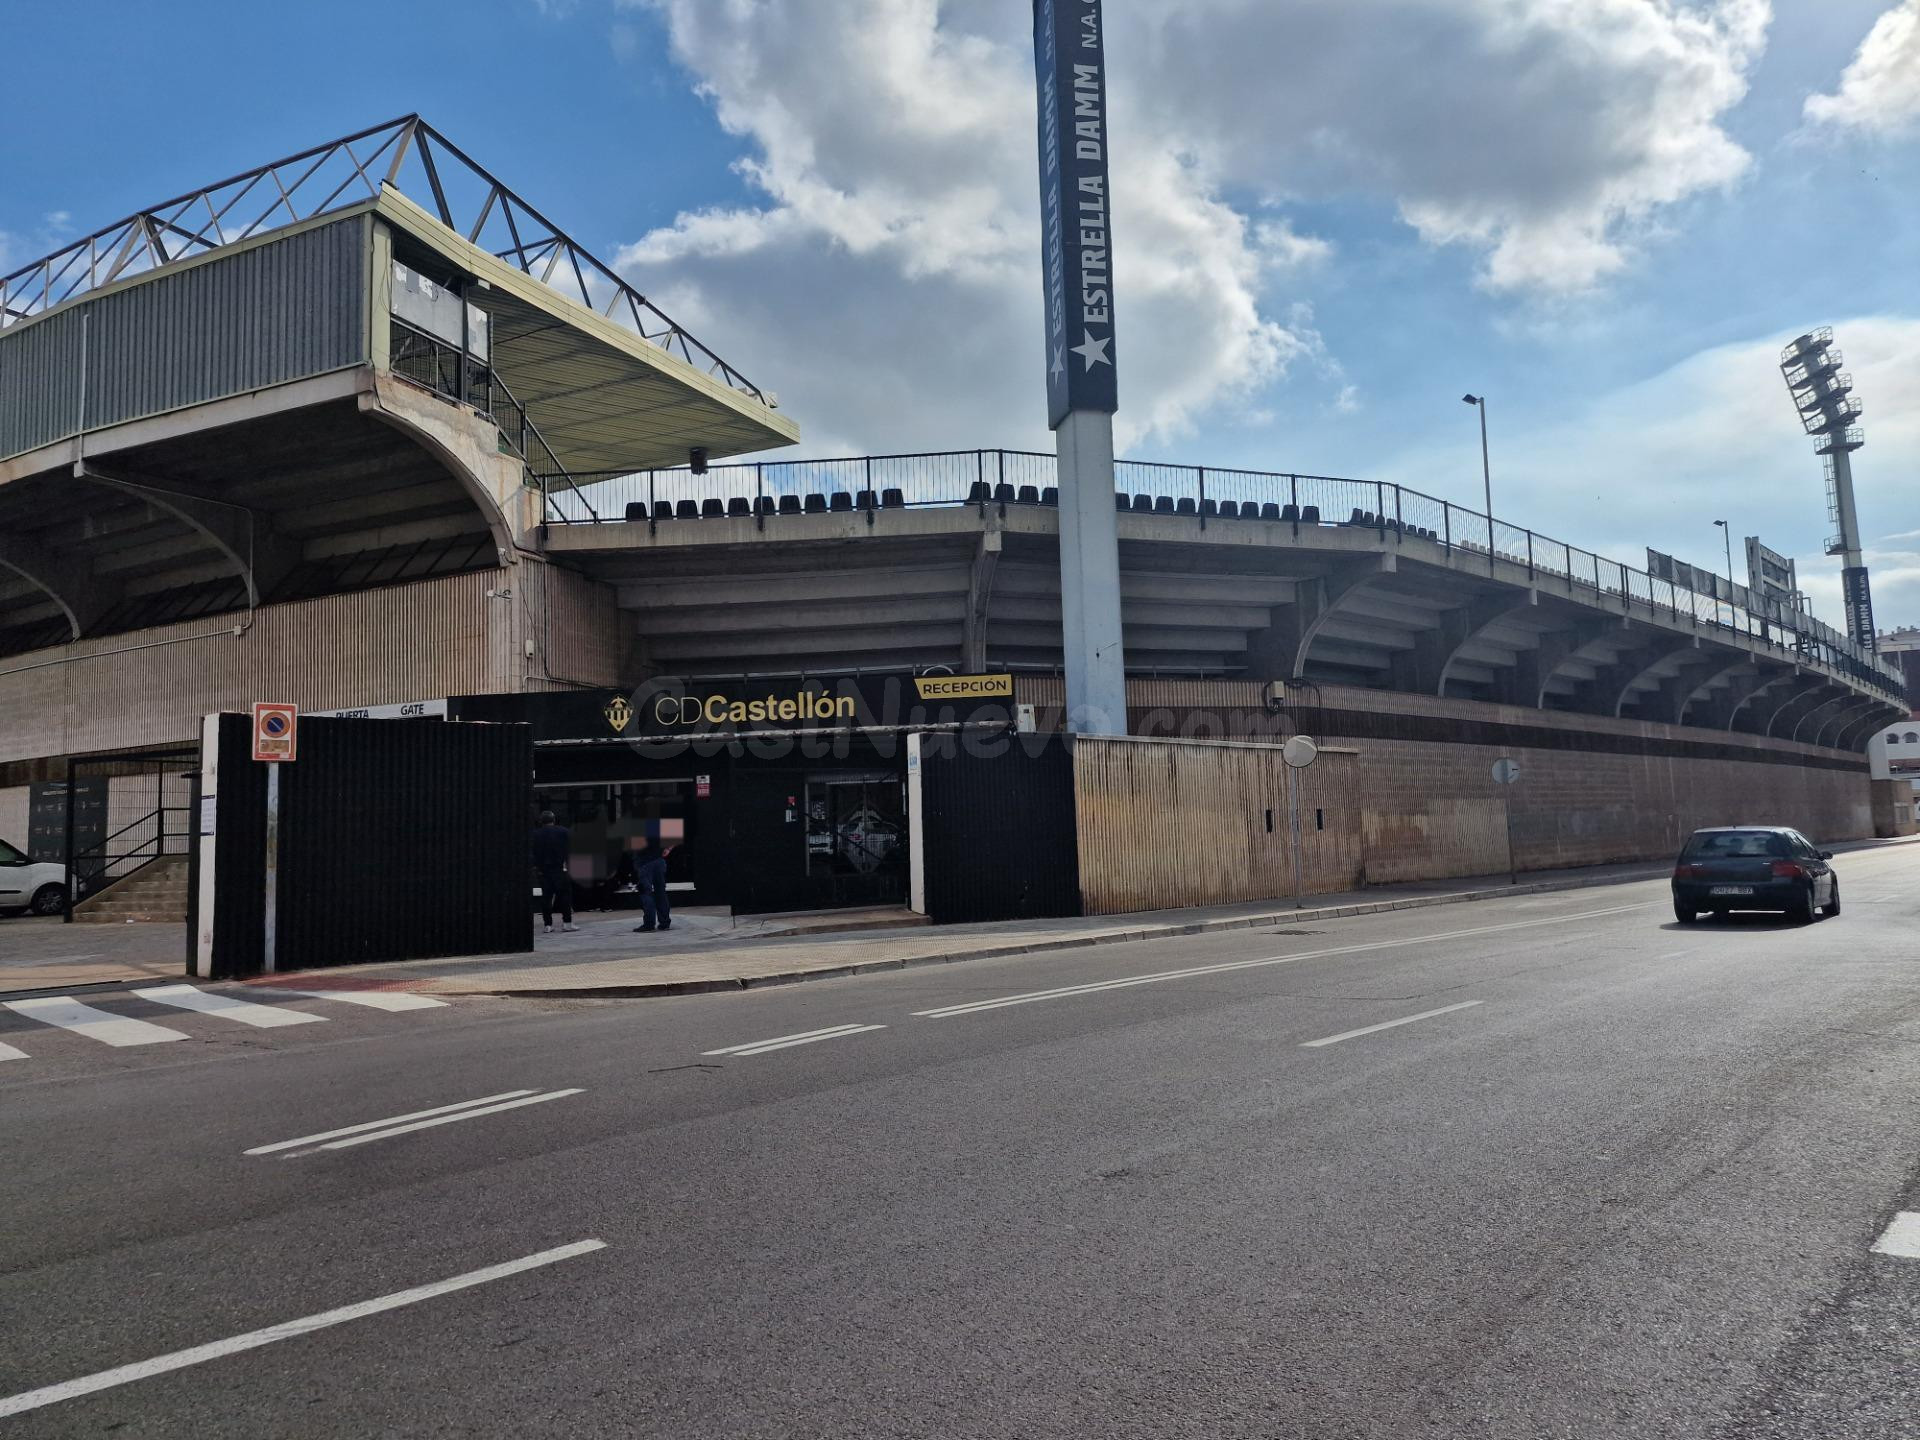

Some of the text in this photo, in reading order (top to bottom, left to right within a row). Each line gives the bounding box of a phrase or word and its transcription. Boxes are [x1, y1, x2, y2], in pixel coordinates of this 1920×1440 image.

[1044, 71, 1056, 177] DAMM
[1074, 63, 1102, 161] DAMM
[1047, 183, 1062, 338] ESTRELLA
[1078, 175, 1109, 324] ESTRELLA
[400, 703, 425, 716] GATE
[923, 678, 1007, 694] RECEPCIÓN
